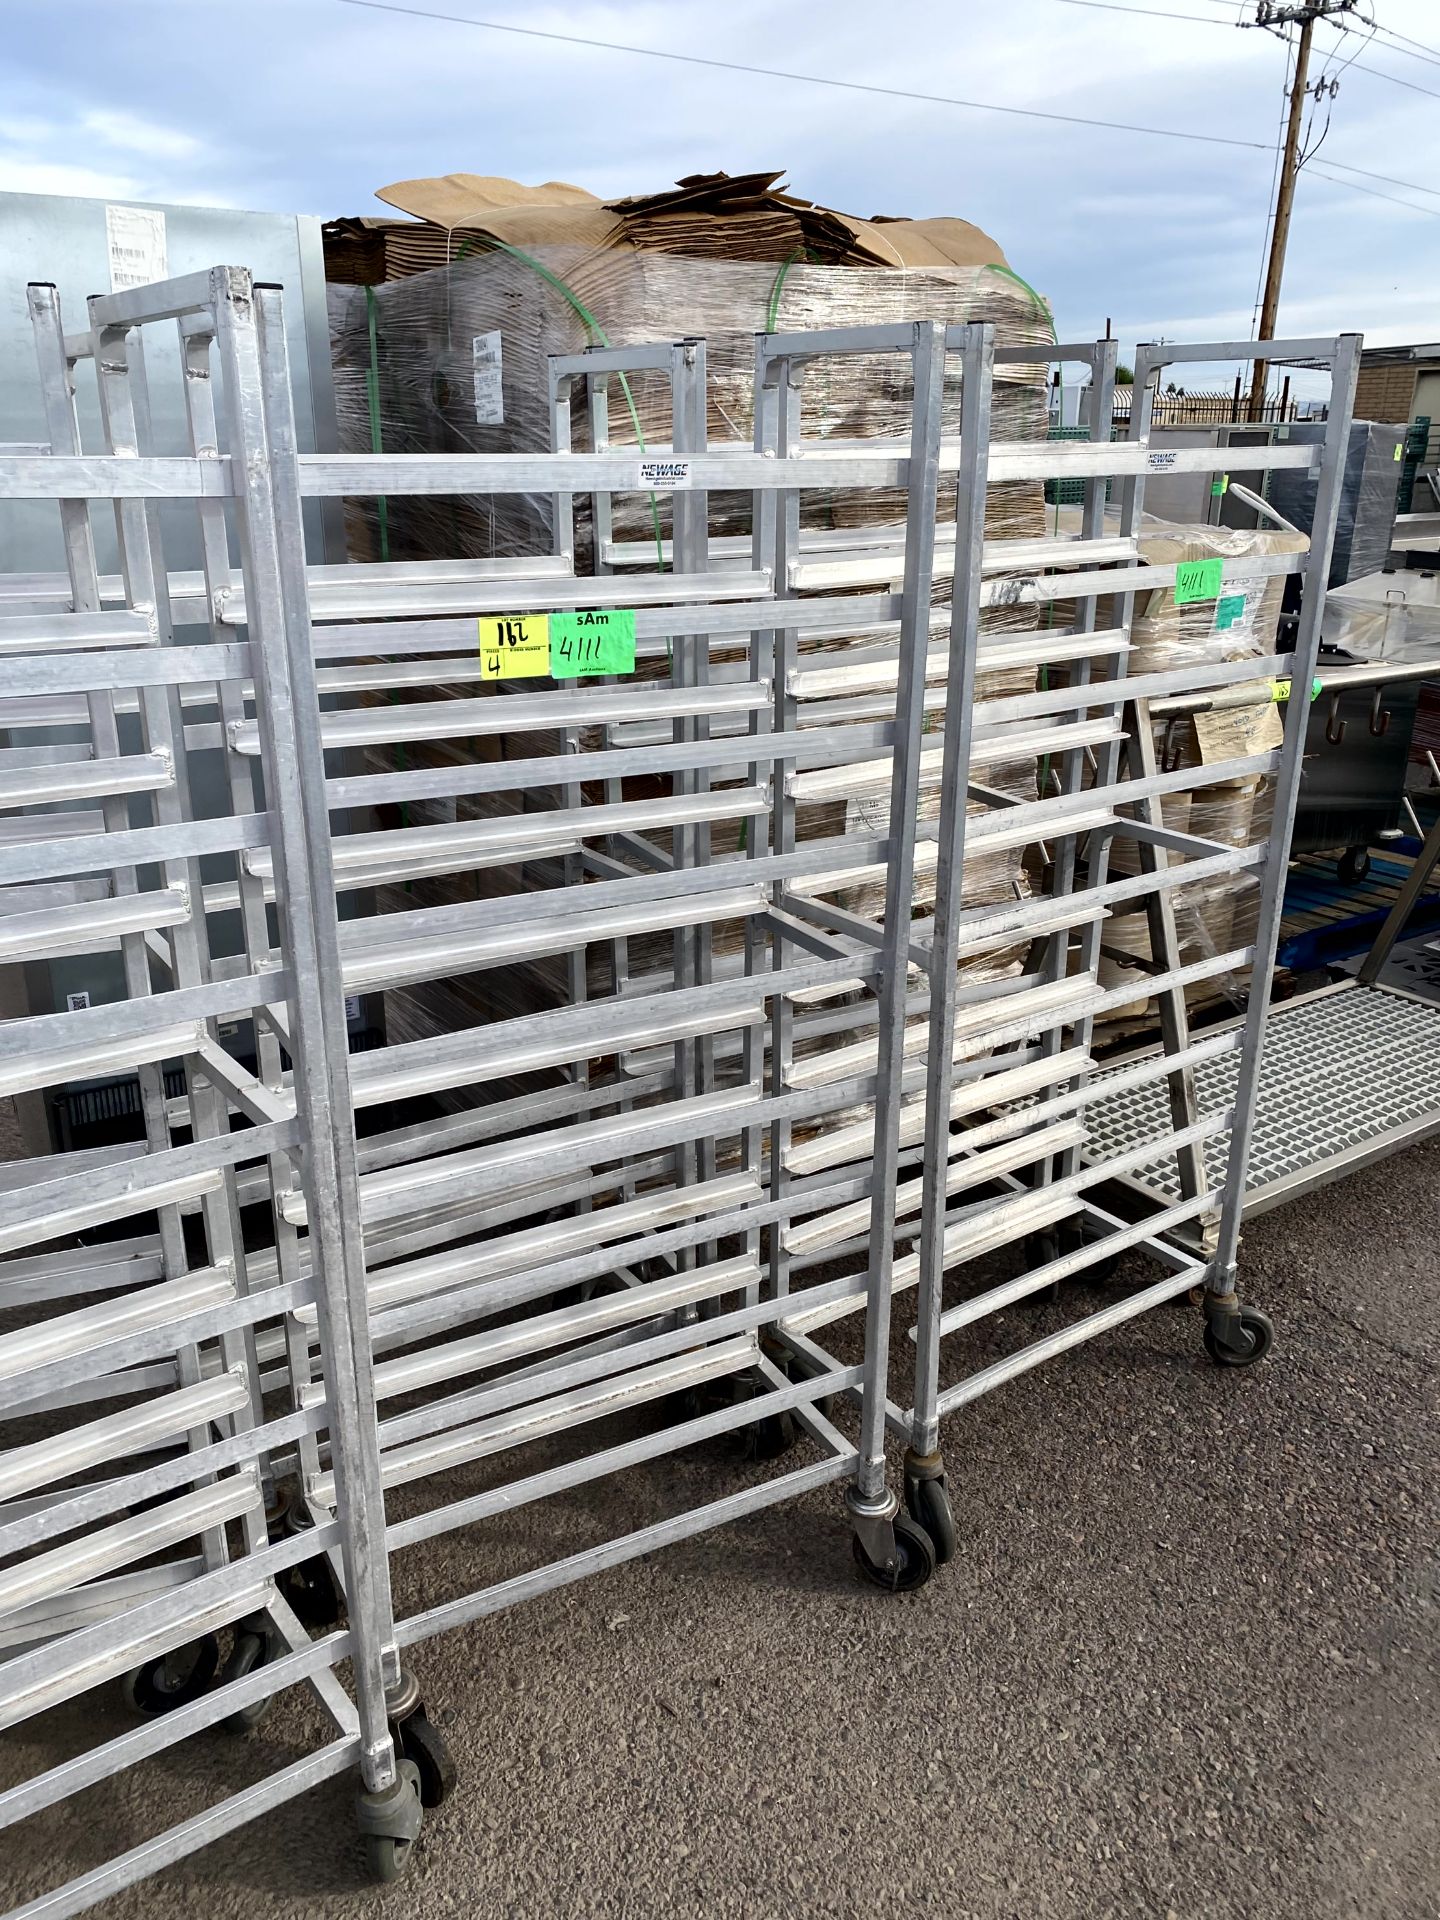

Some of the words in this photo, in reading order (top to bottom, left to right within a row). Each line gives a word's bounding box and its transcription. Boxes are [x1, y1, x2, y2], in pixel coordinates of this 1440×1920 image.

[641, 464, 689, 476] NEWAGE
[1182, 570, 1204, 592] 4111
[577, 612, 609, 625] sAm
[497, 622, 528, 646] 162
[559, 636, 601, 661] 4111
[488, 655, 501, 676] 4
